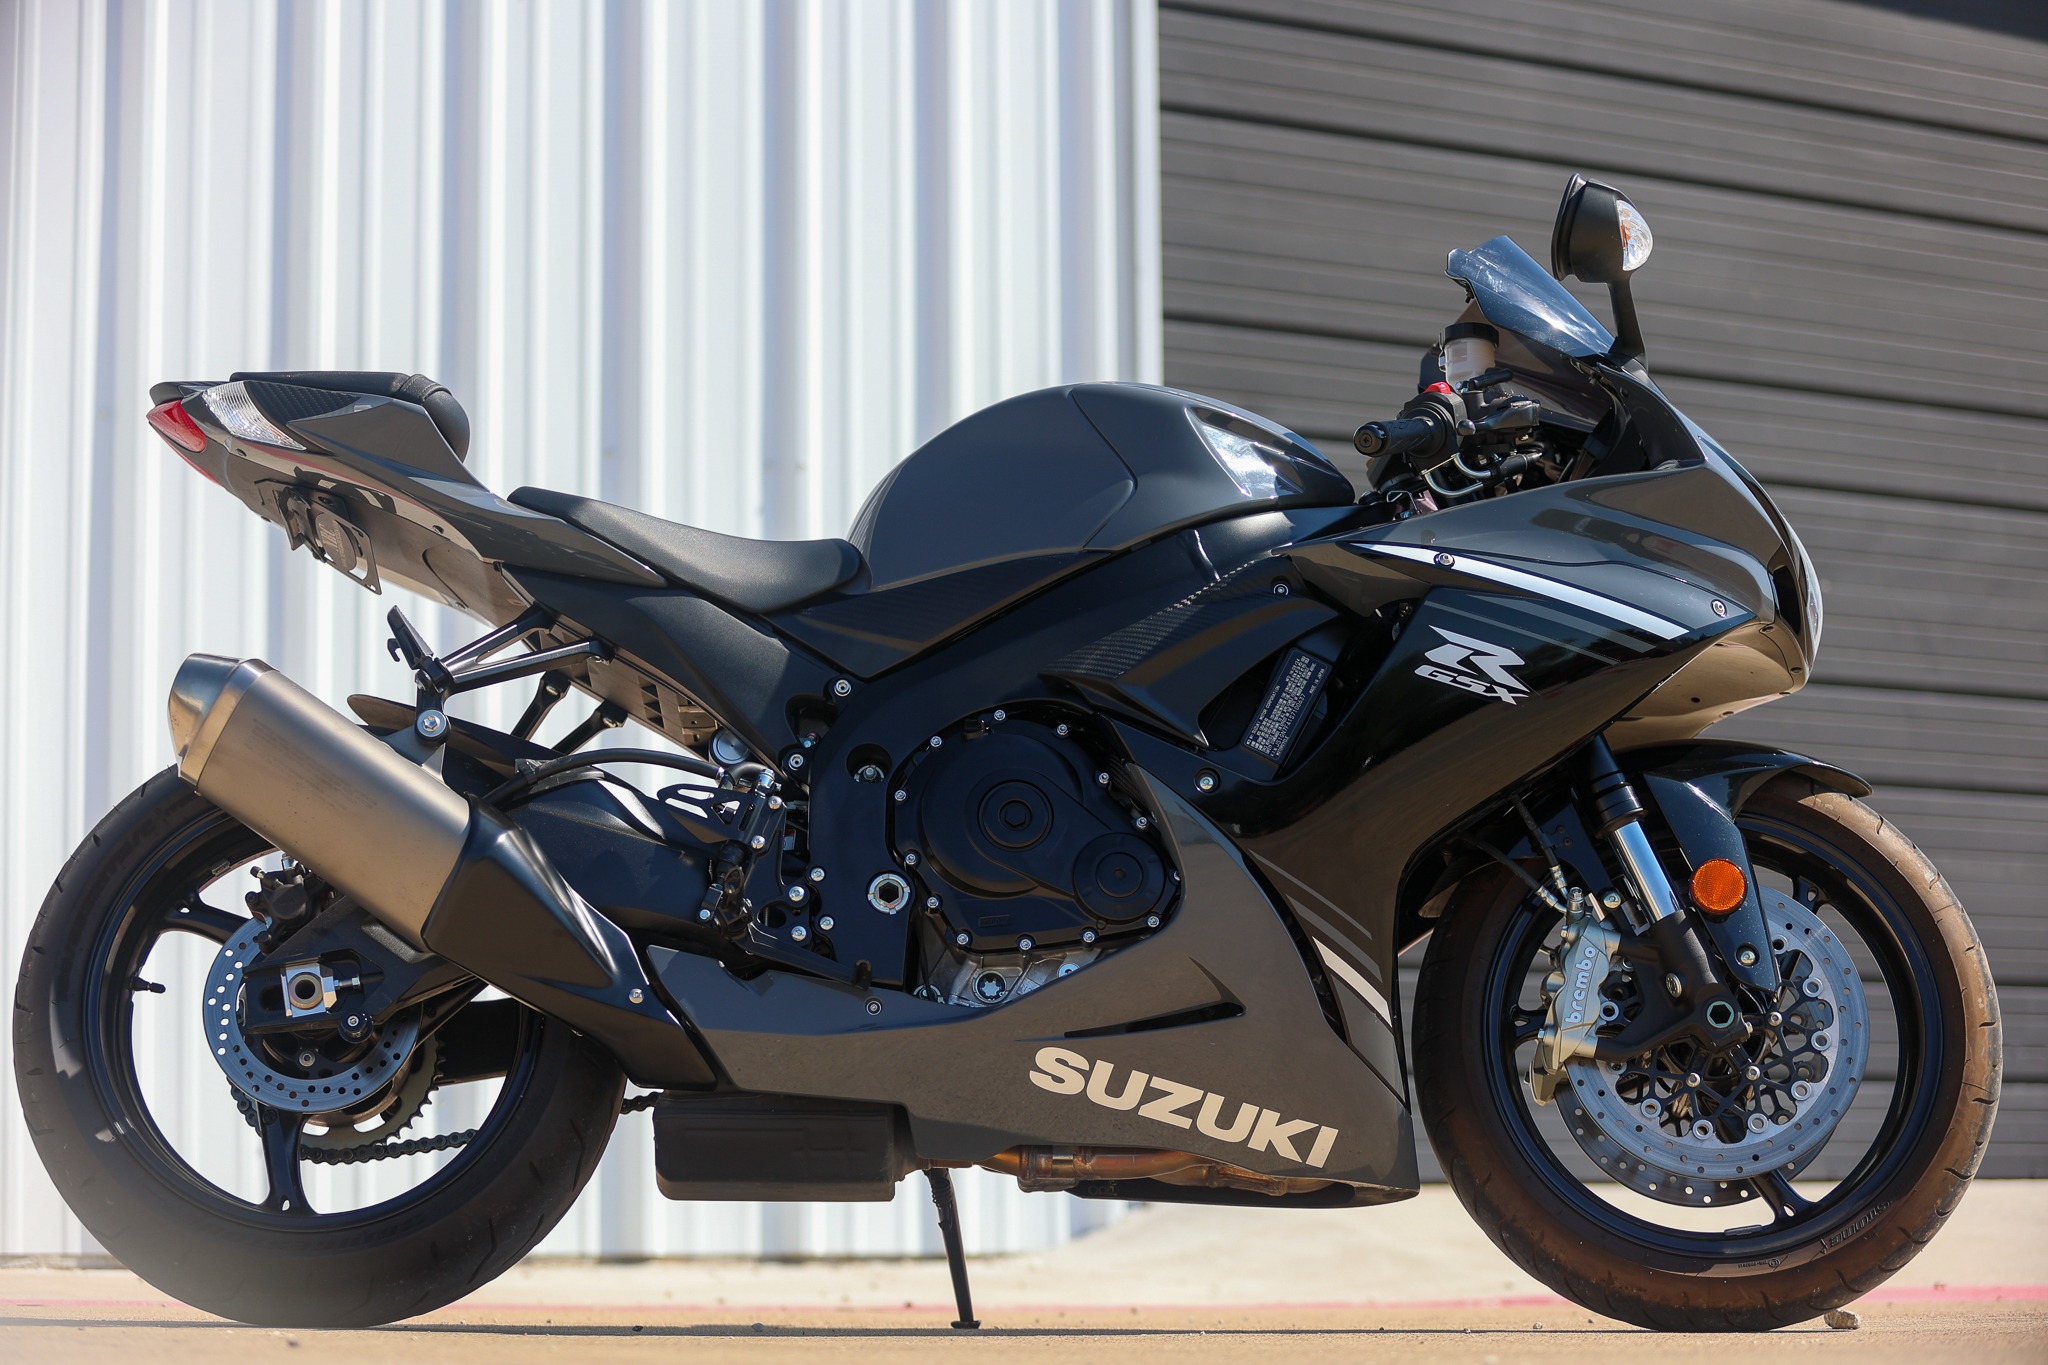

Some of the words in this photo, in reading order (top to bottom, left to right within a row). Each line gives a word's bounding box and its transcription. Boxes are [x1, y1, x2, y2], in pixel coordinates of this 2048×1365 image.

[1259, 708, 1268, 720] MOTOR
[1265, 685, 1281, 708] CORPORATION
[1564, 946, 1597, 1024] brembo
[1029, 1046, 1339, 1169] SUZUKI
